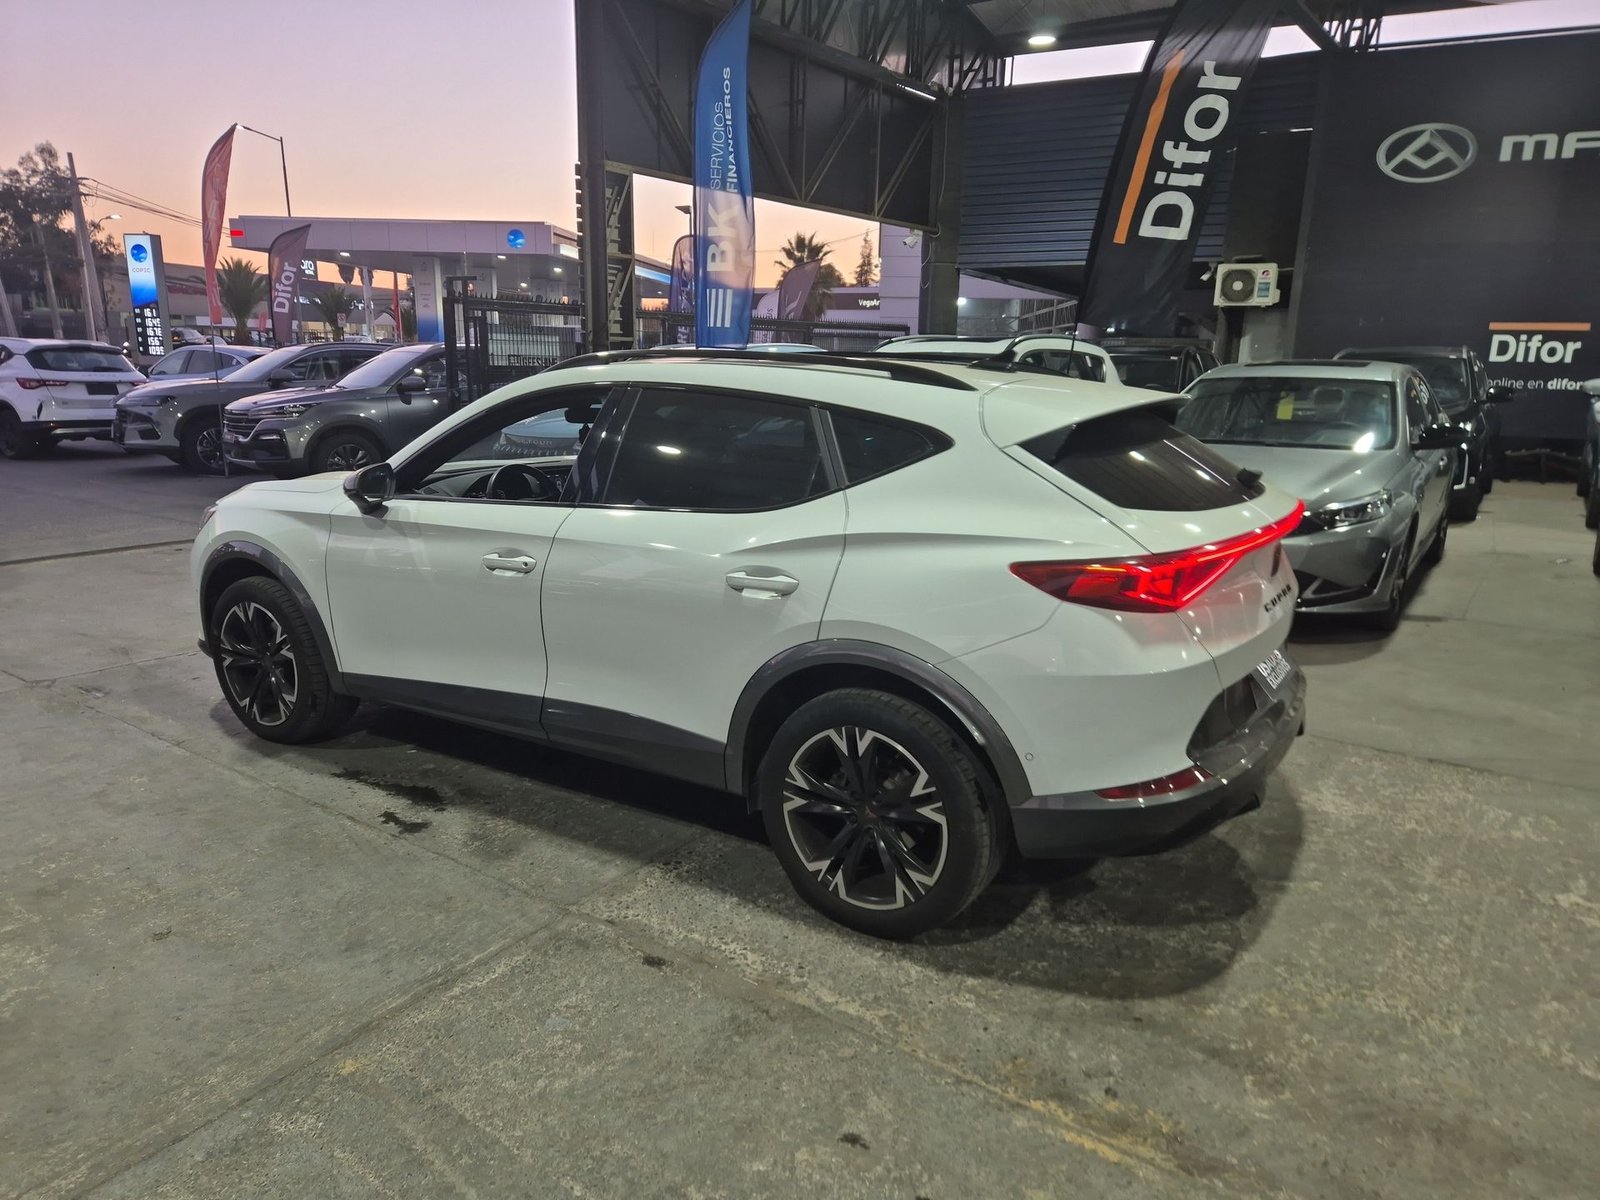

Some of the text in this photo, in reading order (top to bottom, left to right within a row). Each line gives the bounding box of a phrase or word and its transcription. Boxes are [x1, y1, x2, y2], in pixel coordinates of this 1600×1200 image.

[710, 101, 725, 190] SERVICIOS
[722, 66, 738, 193] FINANCIEROS
[1138, 60, 1242, 240] Difor
[706, 202, 739, 272] BK
[273, 262, 297, 314] Difor
[1488, 334, 1582, 363] Difor
[1527, 380, 1543, 389] en
